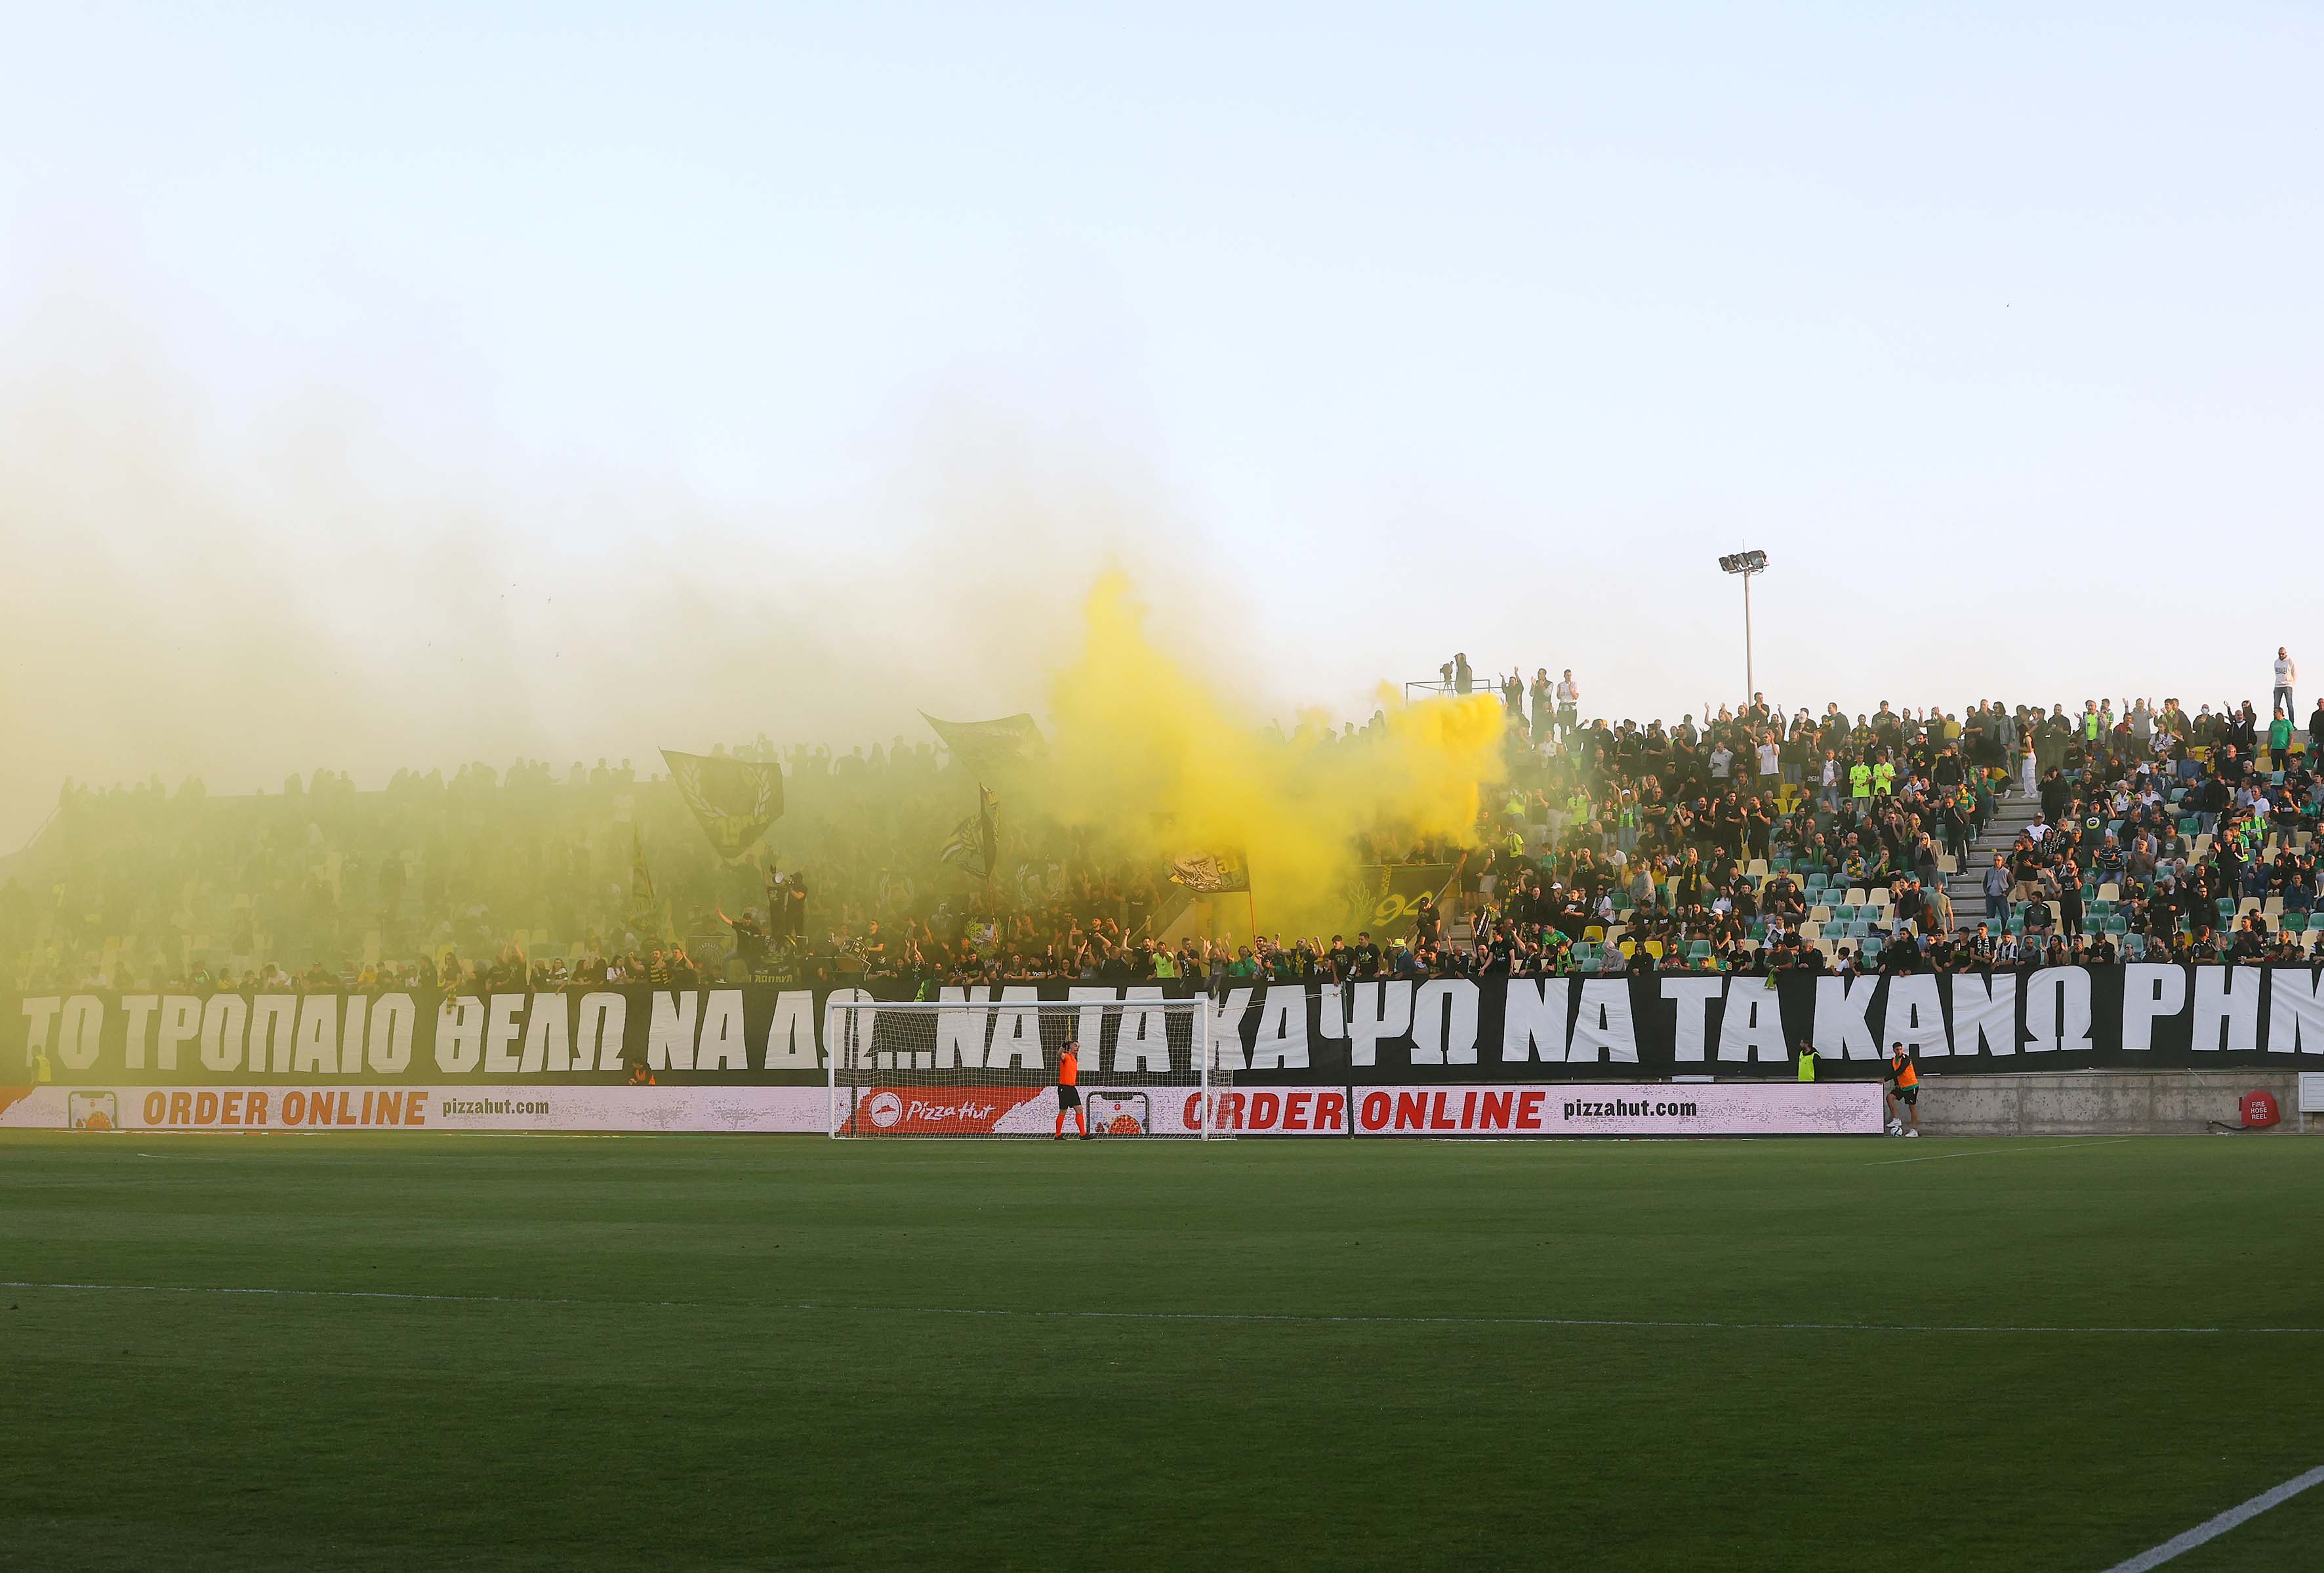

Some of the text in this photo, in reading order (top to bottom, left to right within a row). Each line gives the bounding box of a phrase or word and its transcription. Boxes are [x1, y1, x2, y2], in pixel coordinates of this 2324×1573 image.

[22, 995, 103, 1069] ΤΟ
[121, 993, 416, 1073] ΤΡΟΠΑΙΟ
[434, 992, 626, 1072] ΘΕΛΩ
[648, 990, 748, 1071] ΝΑ
[1068, 986, 1170, 1072] ΤΑ
[1191, 979, 1478, 1071] ΚΑΨΩ
[1503, 977, 1639, 1063] ΝΑ
[1661, 976, 1789, 1061] ΤΑ
[1812, 966, 2092, 1061] ΚΑΝΩ
[143, 1092, 429, 1125] ORDER ONLINE
[442, 1099, 549, 1118] pizzahut.com
[907, 1101, 996, 1121] Pizza Hut
[1183, 1092, 1546, 1130] ORDER ONLINE
[1564, 1099, 1697, 1118] pizzahut.com
